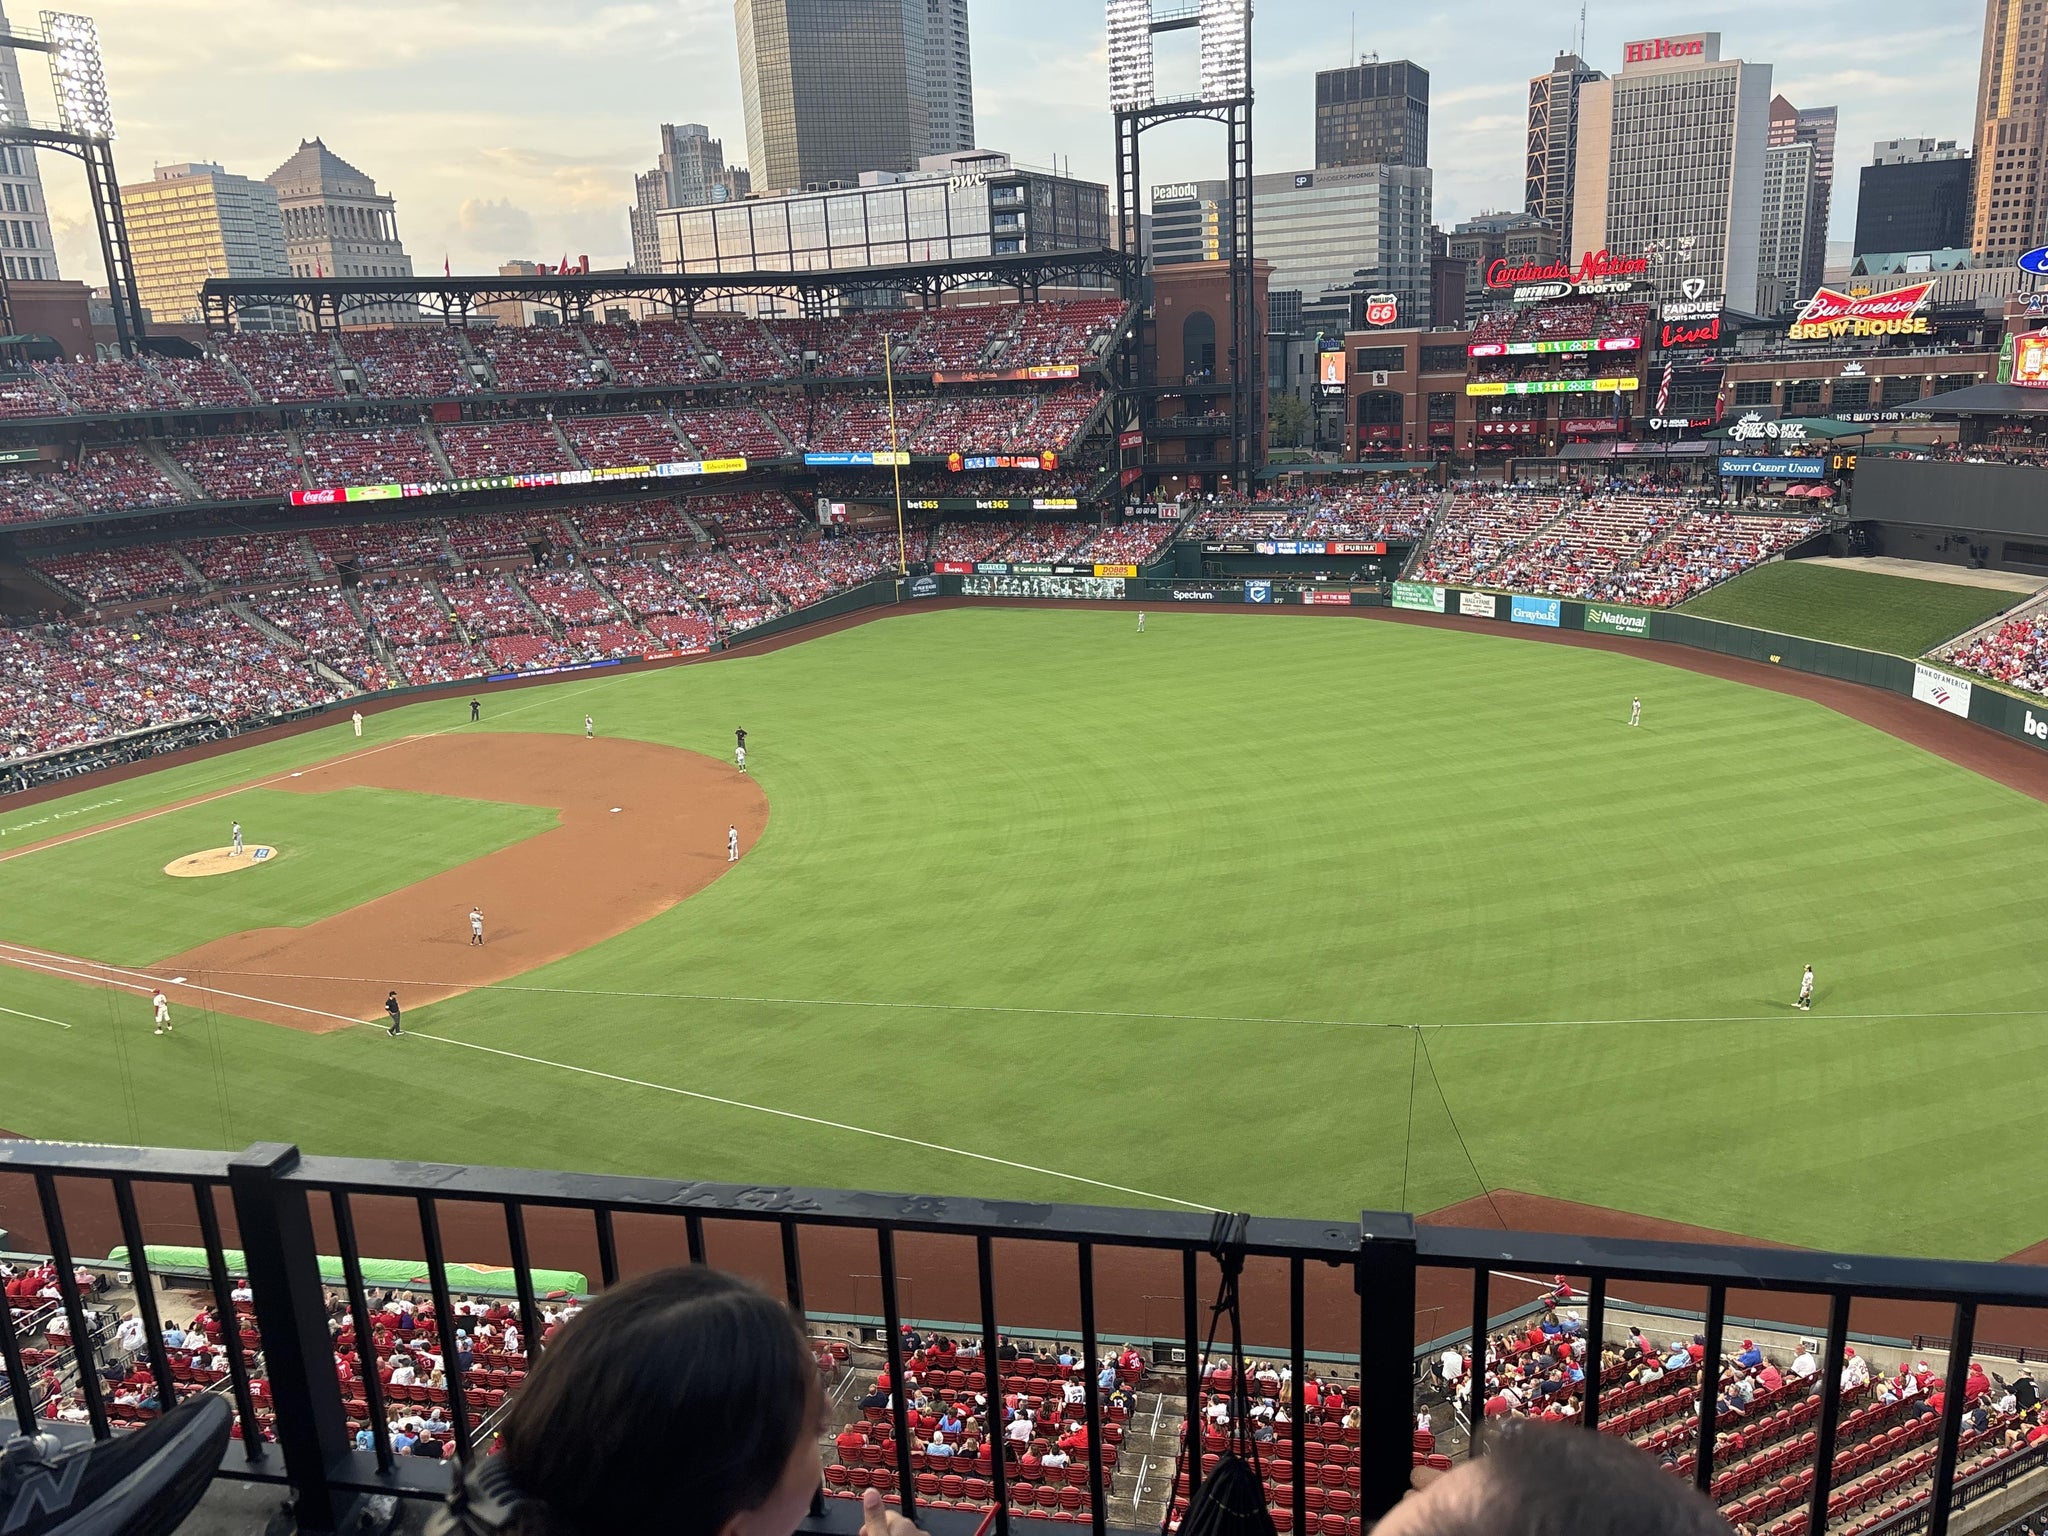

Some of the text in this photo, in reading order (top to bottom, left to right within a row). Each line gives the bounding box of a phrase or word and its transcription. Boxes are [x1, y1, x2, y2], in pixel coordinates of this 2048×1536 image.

[1626, 38, 1704, 62] Hilton
[949, 173, 986, 193] pwc
[1153, 183, 1198, 199] Peabody
[1487, 250, 1647, 288] Cardinals Nation
[1514, 283, 1632, 298] HOFFMANN ROOFTOP
[1370, 296, 1394, 304] PHILLIPS
[1371, 306, 1392, 319] 66
[1664, 302, 1720, 314] FANDUEL
[1793, 296, 1928, 321] Budweiser
[1689, 313, 1719, 321] NETWORK
[1662, 319, 1719, 347] Live!
[1789, 317, 1928, 340] BREW HOUSE
[1853, 412, 1879, 421] BUD'S
[1881, 411, 1898, 420] FOR
[1690, 418, 1710, 428] Live!
[1781, 424, 1803, 432] MVP
[1780, 431, 1807, 439] DECK
[1722, 462, 1820, 473] SCOTT CREDIT UNION
[907, 500, 939, 509] bet365
[976, 500, 1009, 509] bet365
[1173, 591, 1213, 600] Spectrum
[1601, 612, 1646, 627] National
[1917, 667, 1969, 691] BANK OF AMERICA
[1129, 1357, 1140, 1369] 30
